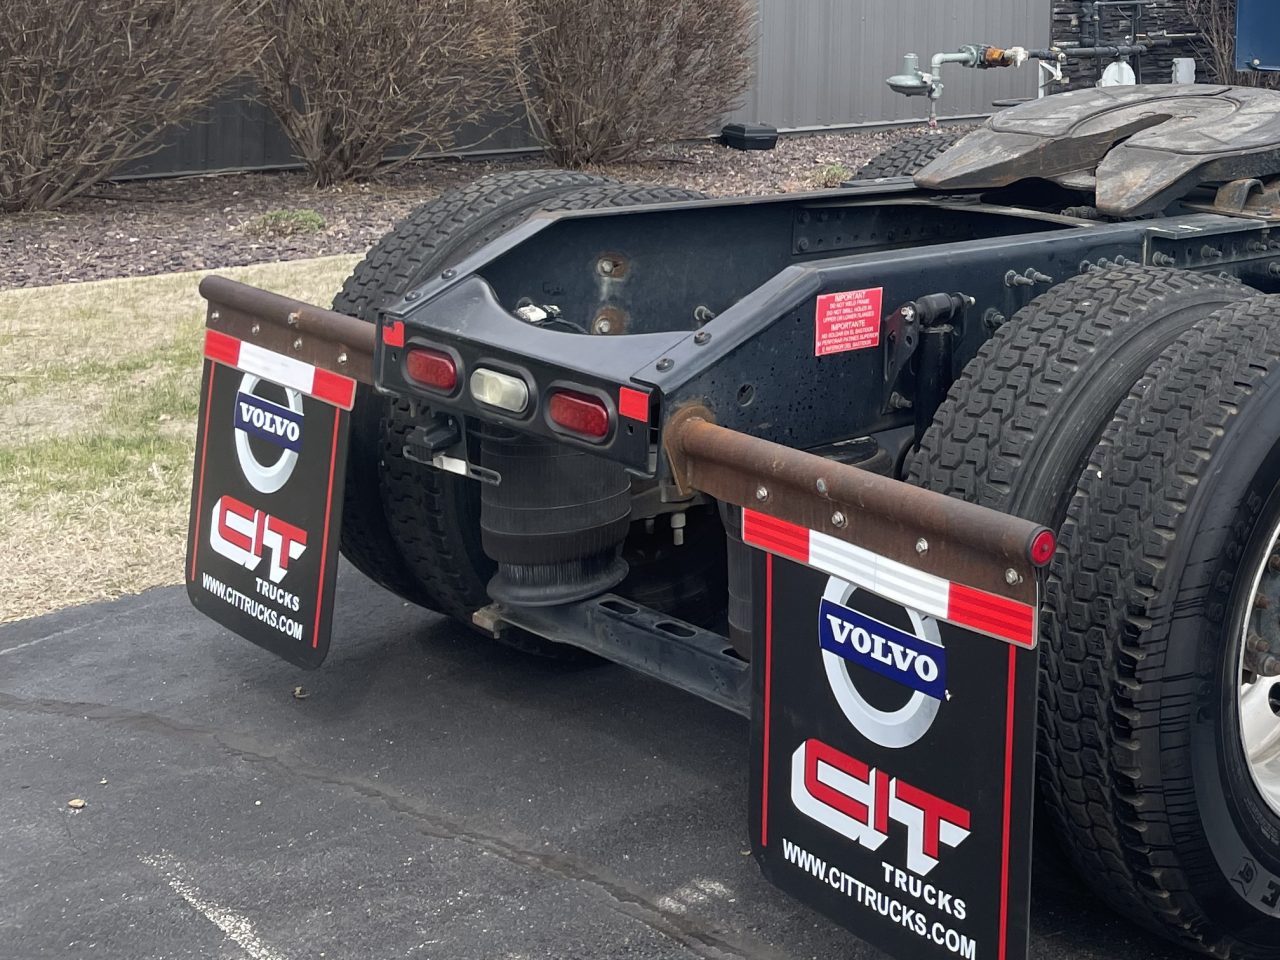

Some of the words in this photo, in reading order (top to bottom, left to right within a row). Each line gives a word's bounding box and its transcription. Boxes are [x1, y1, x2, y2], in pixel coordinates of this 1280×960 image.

[831, 320, 866, 332] IMPORTANTE
[239, 401, 300, 442] VOLVO
[210, 495, 308, 583] CIT
[202, 572, 303, 640] WWW.CITTRUCKS.COM
[255, 578, 300, 612] TRUCKS
[826, 613, 938, 682] VOLVO
[791, 738, 971, 876] CIT
[782, 838, 976, 960] WWW.CITTRUCKS.COM
[881, 861, 967, 920] TRUCKS
